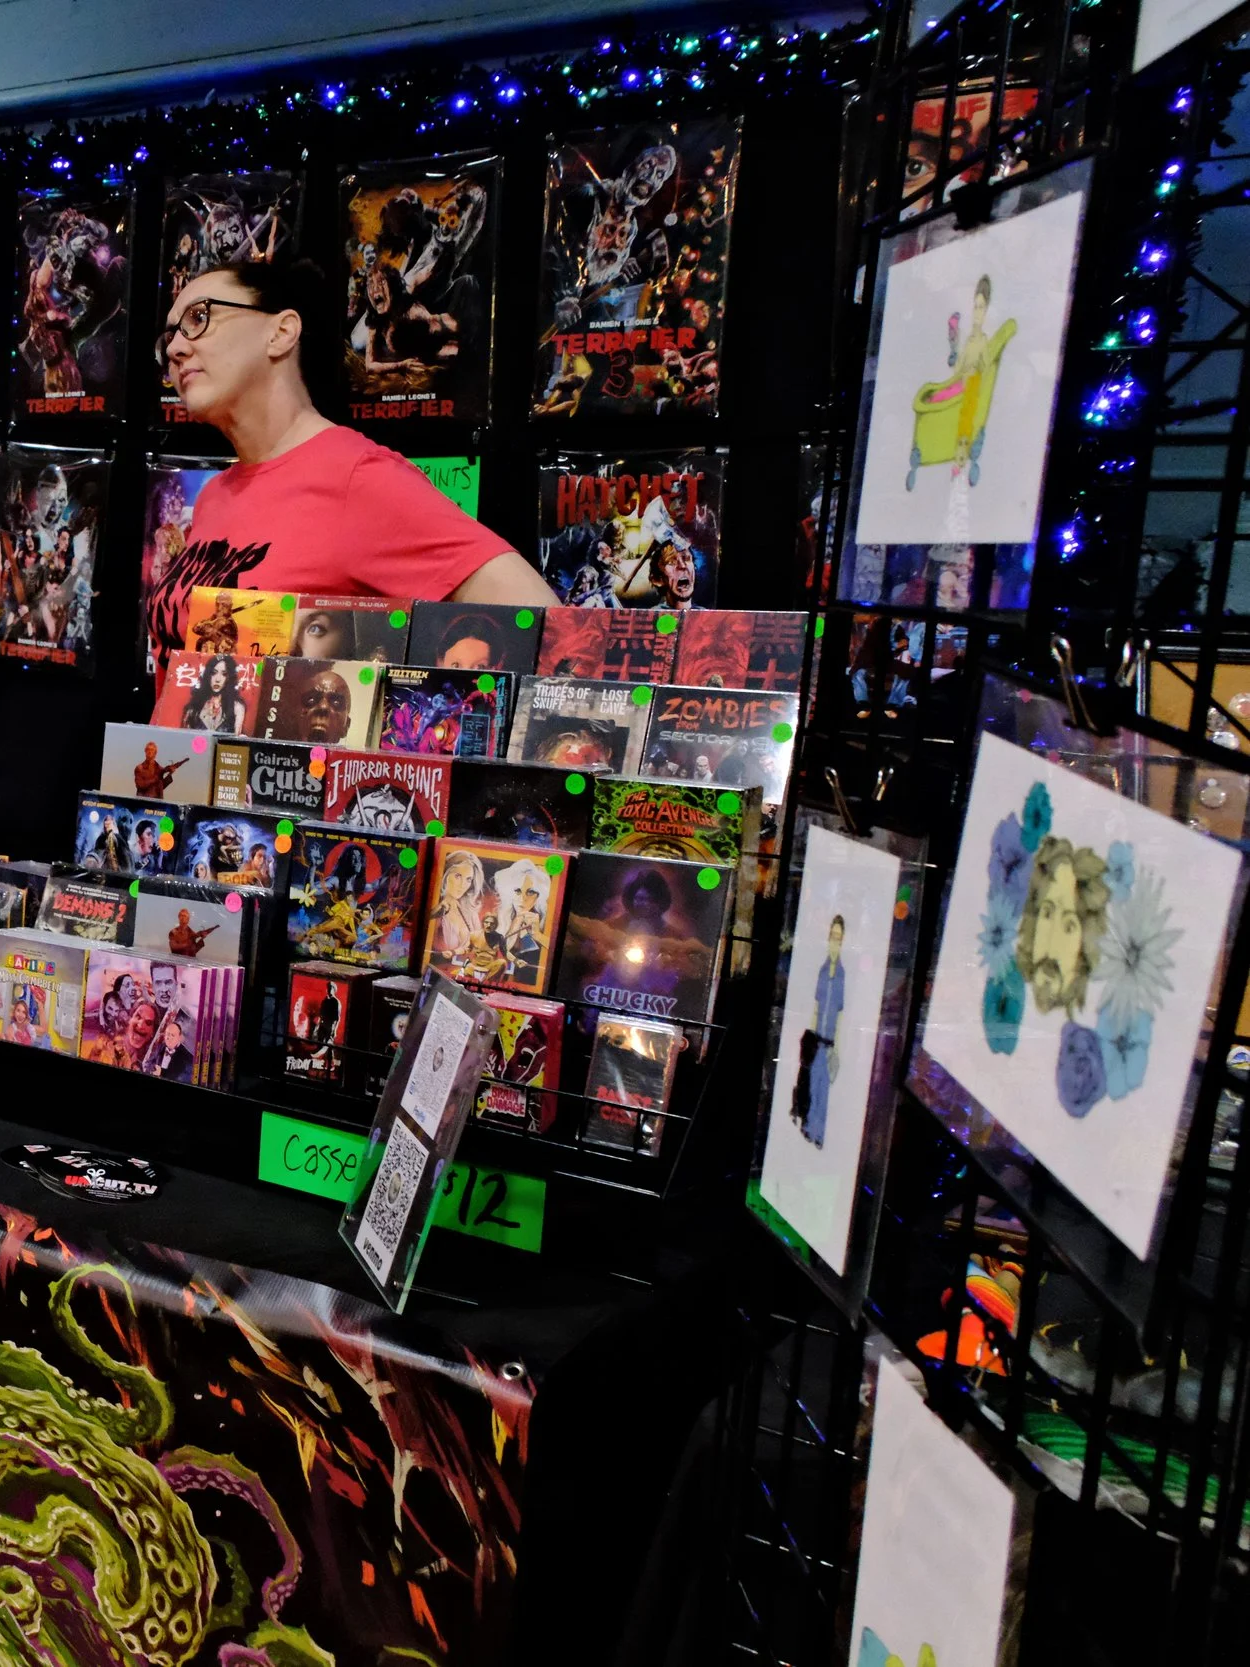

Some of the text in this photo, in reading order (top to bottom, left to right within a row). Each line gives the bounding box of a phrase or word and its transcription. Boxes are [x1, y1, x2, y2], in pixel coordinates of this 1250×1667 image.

[591, 320, 620, 329] DAMIEN
[552, 328, 696, 354] TERRIFIER
[602, 348, 635, 398] 3
[26, 396, 105, 414] TERRIFIER
[349, 400, 454, 419] TERRIFIER
[557, 471, 705, 528] HATCHET
[0, 641, 77, 666] TERRIFIER
[533, 684, 590, 699] TRACES OF
[602, 689, 630, 702] LOST
[533, 697, 565, 710] SNUFF
[600, 702, 626, 715] CAVE
[658, 698, 787, 728] ZOMBIES
[659, 731, 732, 744] SECTOR
[254, 752, 299, 767] Gaira's
[251, 765, 323, 797] Guts
[327, 760, 442, 819] J-HORROR RISING
[218, 792, 238, 800] BODY
[275, 789, 322, 808] Trilogy
[625, 790, 648, 803] THE
[617, 802, 656, 820] TOXIC
[634, 821, 695, 836] COLLECTION
[52, 893, 115, 919] DEMONS
[116, 904, 127, 922] 2
[5, 954, 55, 975] EATING
[584, 985, 678, 1016] CHUCKY
[286, 1056, 311, 1071] FRIDAY
[312, 1060, 325, 1070] THE
[491, 1086, 520, 1102] BRAIN
[487, 1096, 525, 1115] DAMAGE
[362, 1238, 383, 1271] venmo
